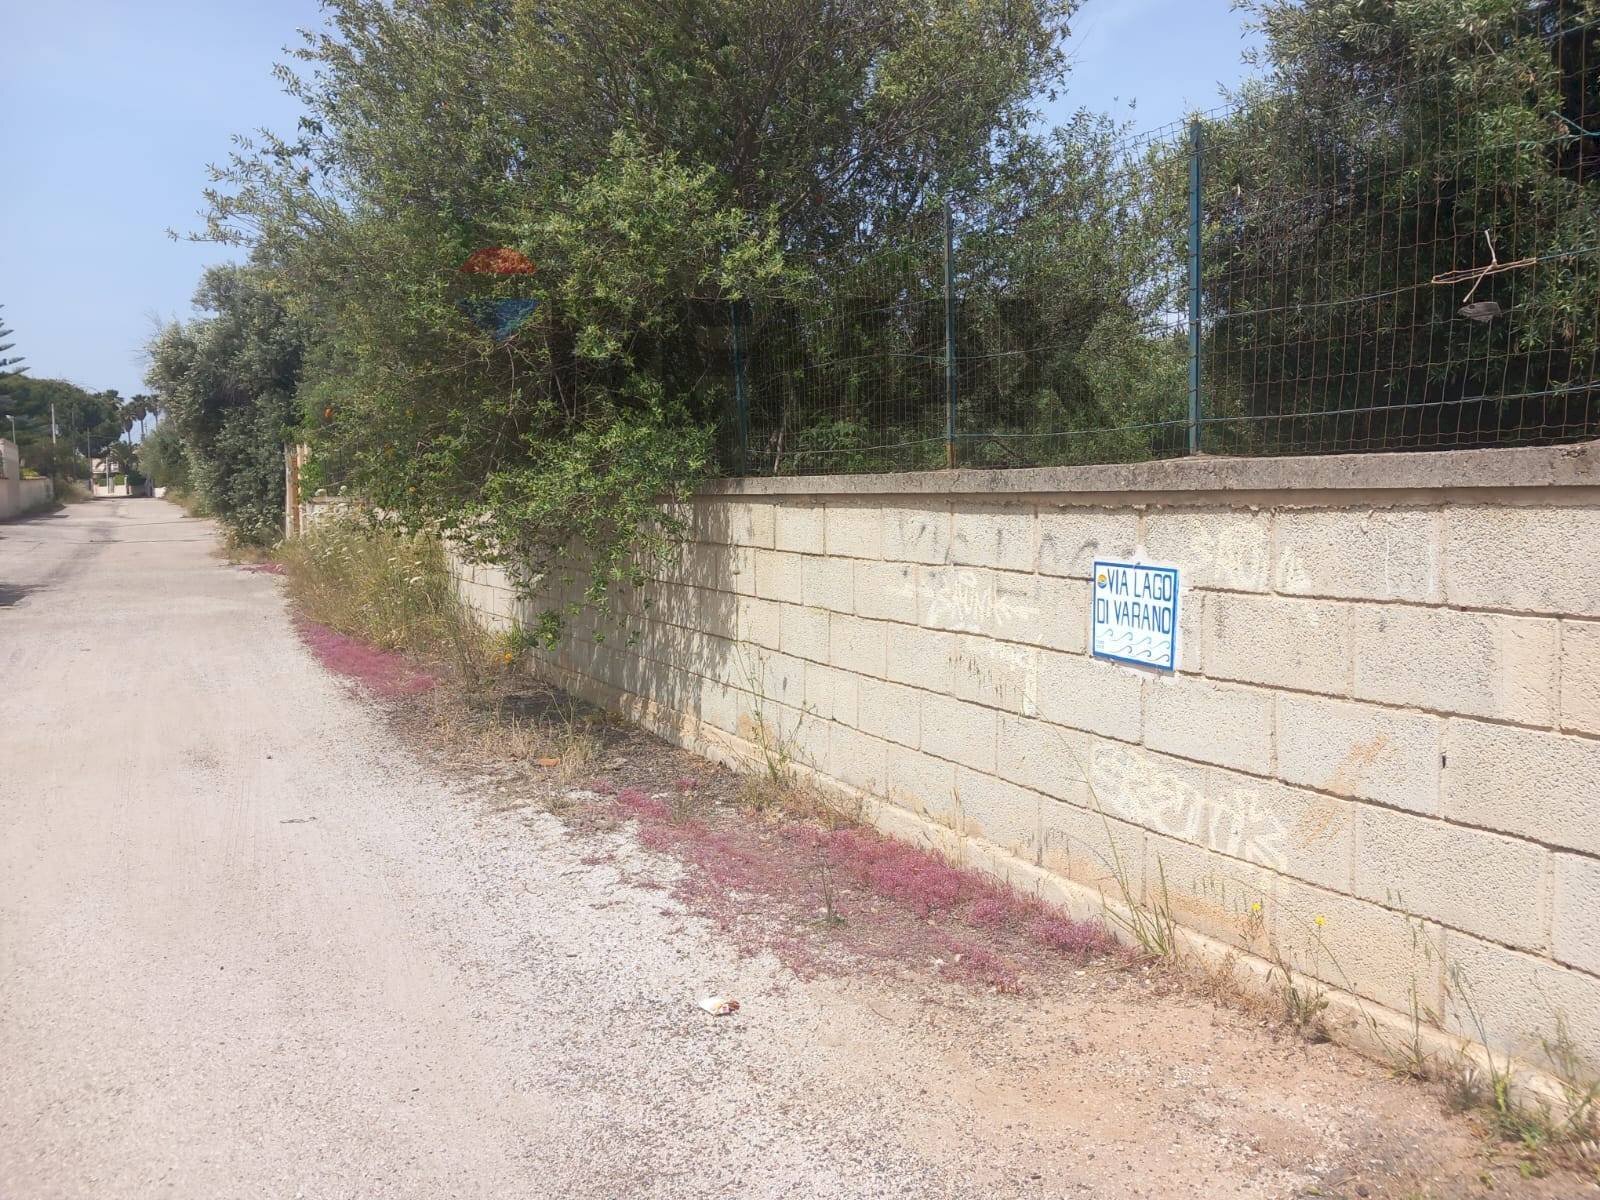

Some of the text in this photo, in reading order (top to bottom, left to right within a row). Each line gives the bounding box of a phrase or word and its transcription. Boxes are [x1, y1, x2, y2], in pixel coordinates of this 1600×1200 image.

[1107, 568, 1172, 602] VIA LAGO
[1097, 598, 1171, 634] DI VARANO
